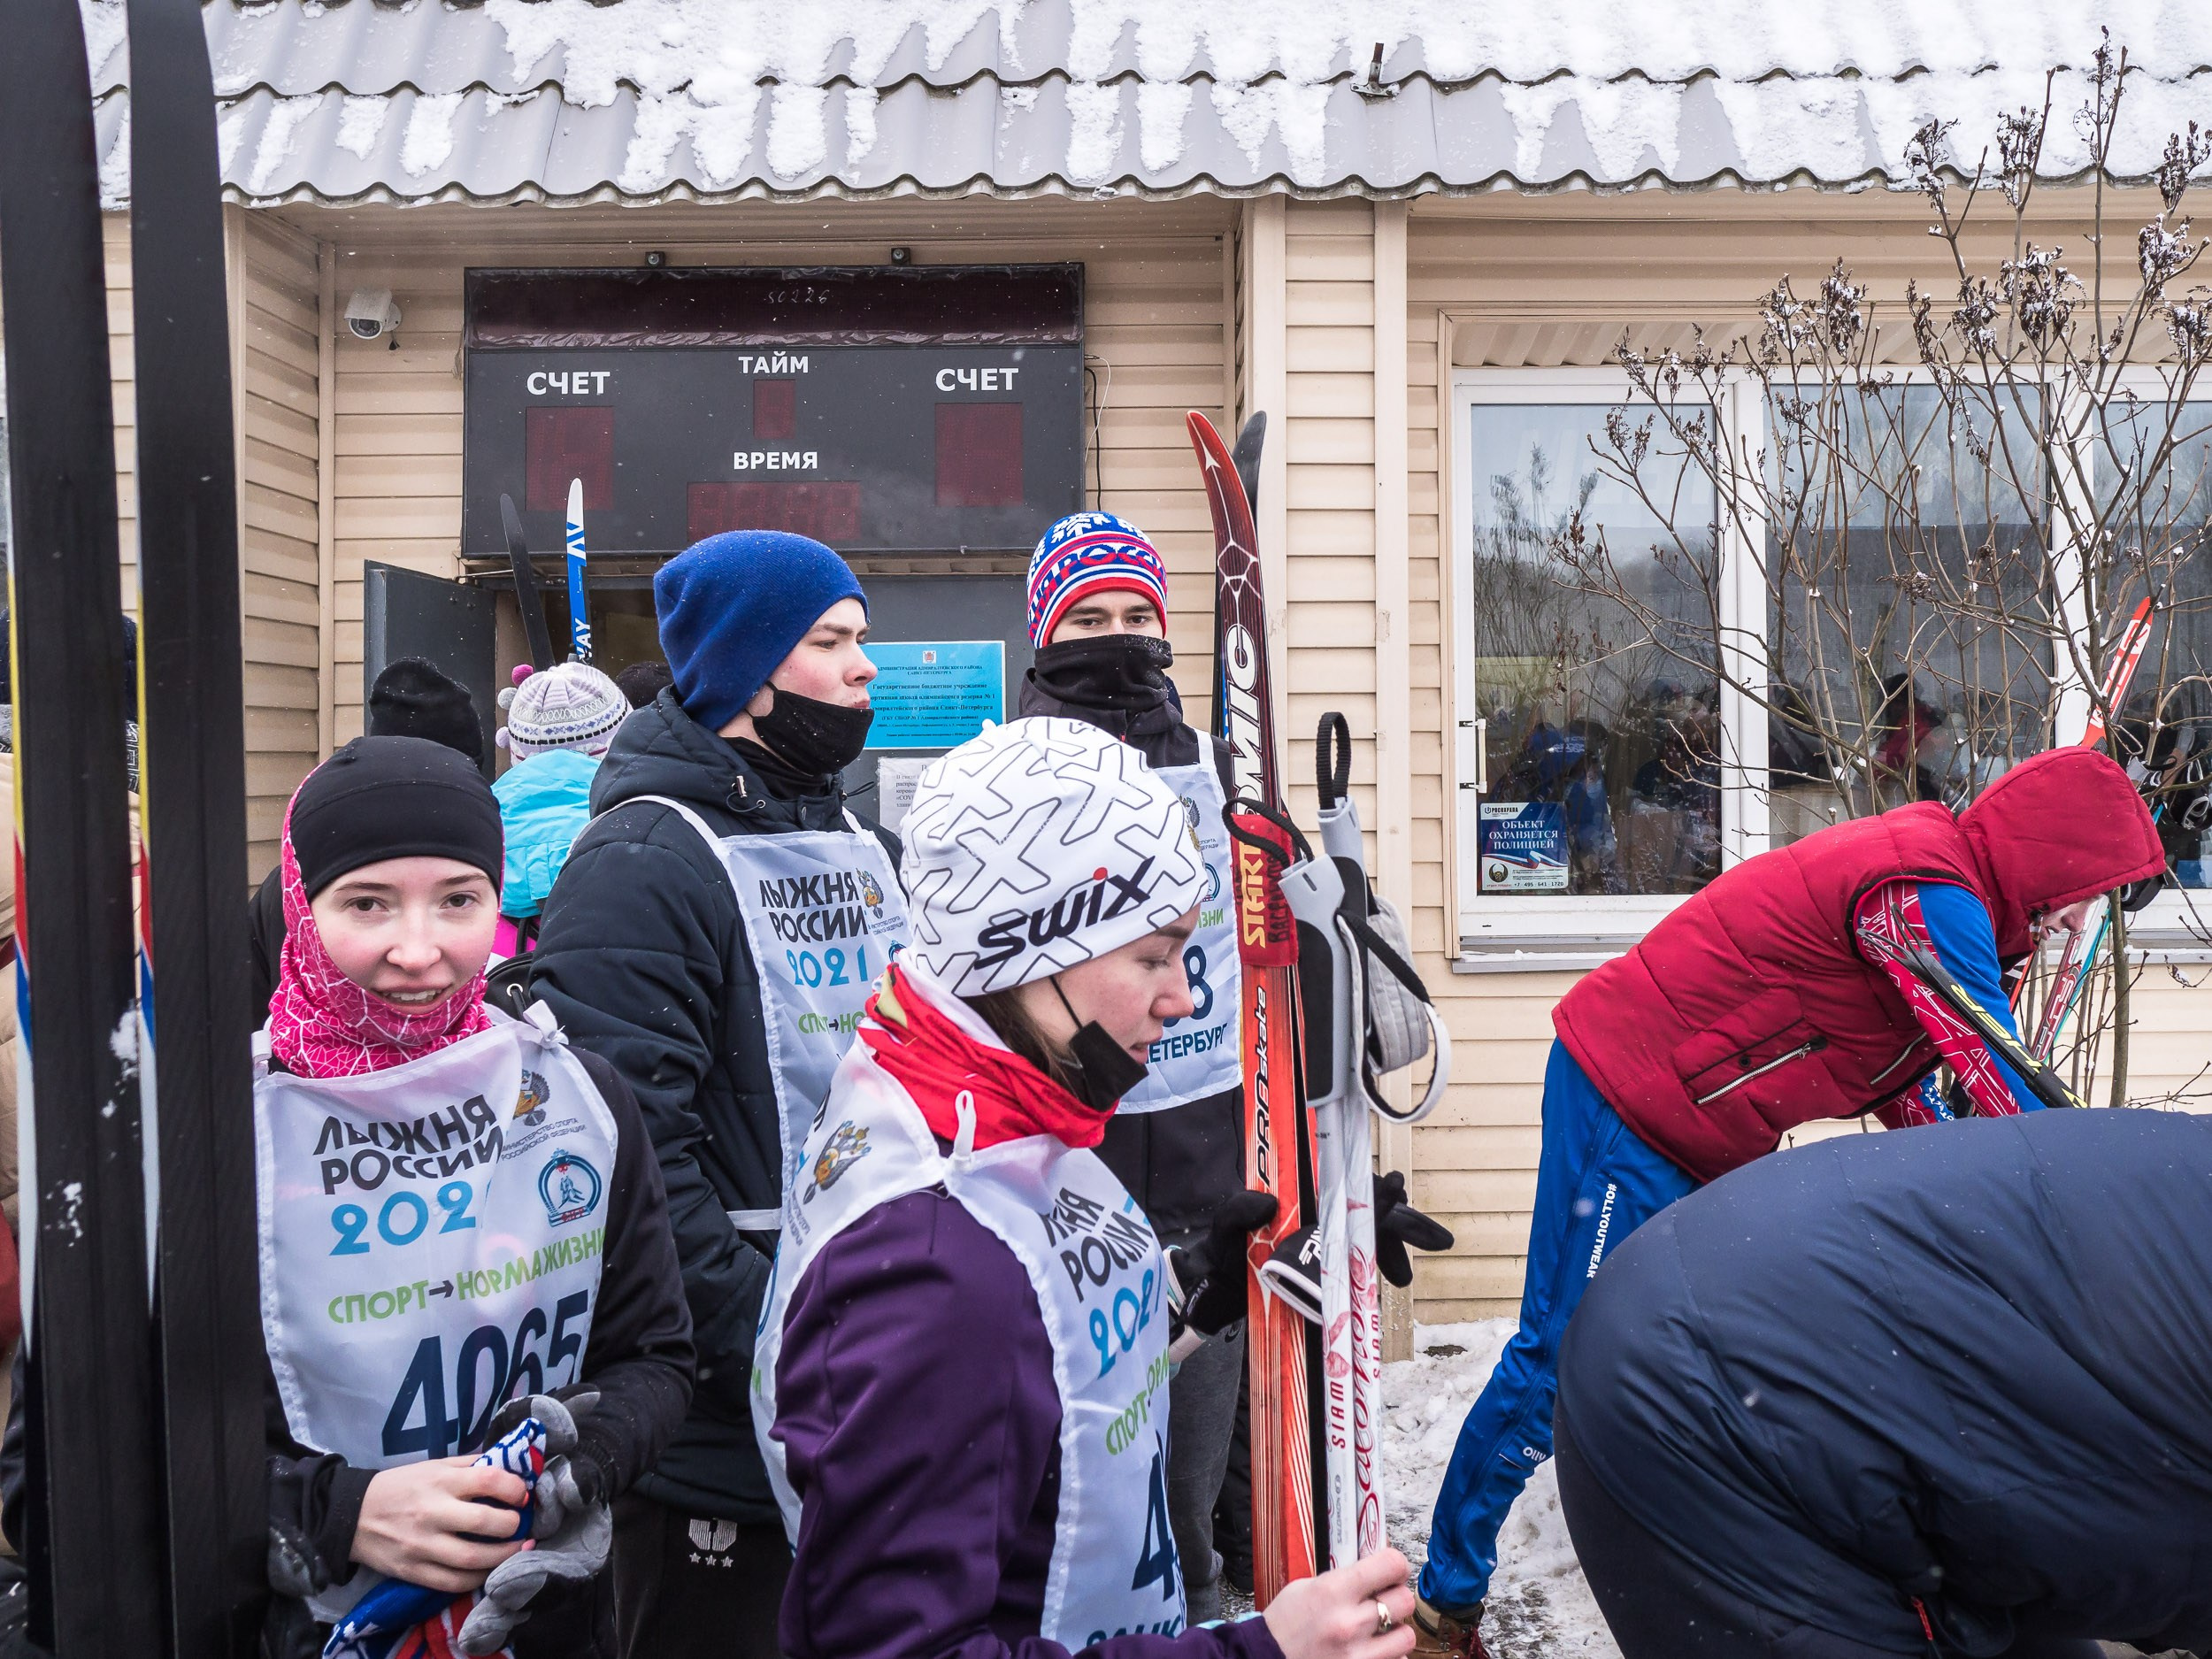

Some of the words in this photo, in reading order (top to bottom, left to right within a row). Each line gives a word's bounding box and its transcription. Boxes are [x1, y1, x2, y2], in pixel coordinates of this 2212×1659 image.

[739, 350, 810, 374] ТАЙМ
[934, 367, 1019, 392] СЧЕТ
[526, 371, 611, 396] СЧЕТ
[733, 451, 818, 470] ВРЕМЯ
[1489, 830, 1558, 840] ОХРАНЯЕТСЯ
[1502, 820, 1545, 829] ОБЪЕКТ
[1494, 839, 1555, 850] ПОЛИЦИЕЙ
[759, 872, 859, 909] ЛЫЖНЯ
[768, 905, 869, 943] РОССИИ
[786, 943, 869, 988] 2021
[312, 1094, 497, 1156] ЛЫЖНЯ
[321, 1126, 503, 1195] РОССИИ
[328, 1178, 492, 1256] 202
[328, 1279, 430, 1325] СПОРТ
[381, 1290, 588, 1460] 4065
[1331, 1379, 1346, 1449] SIAM
